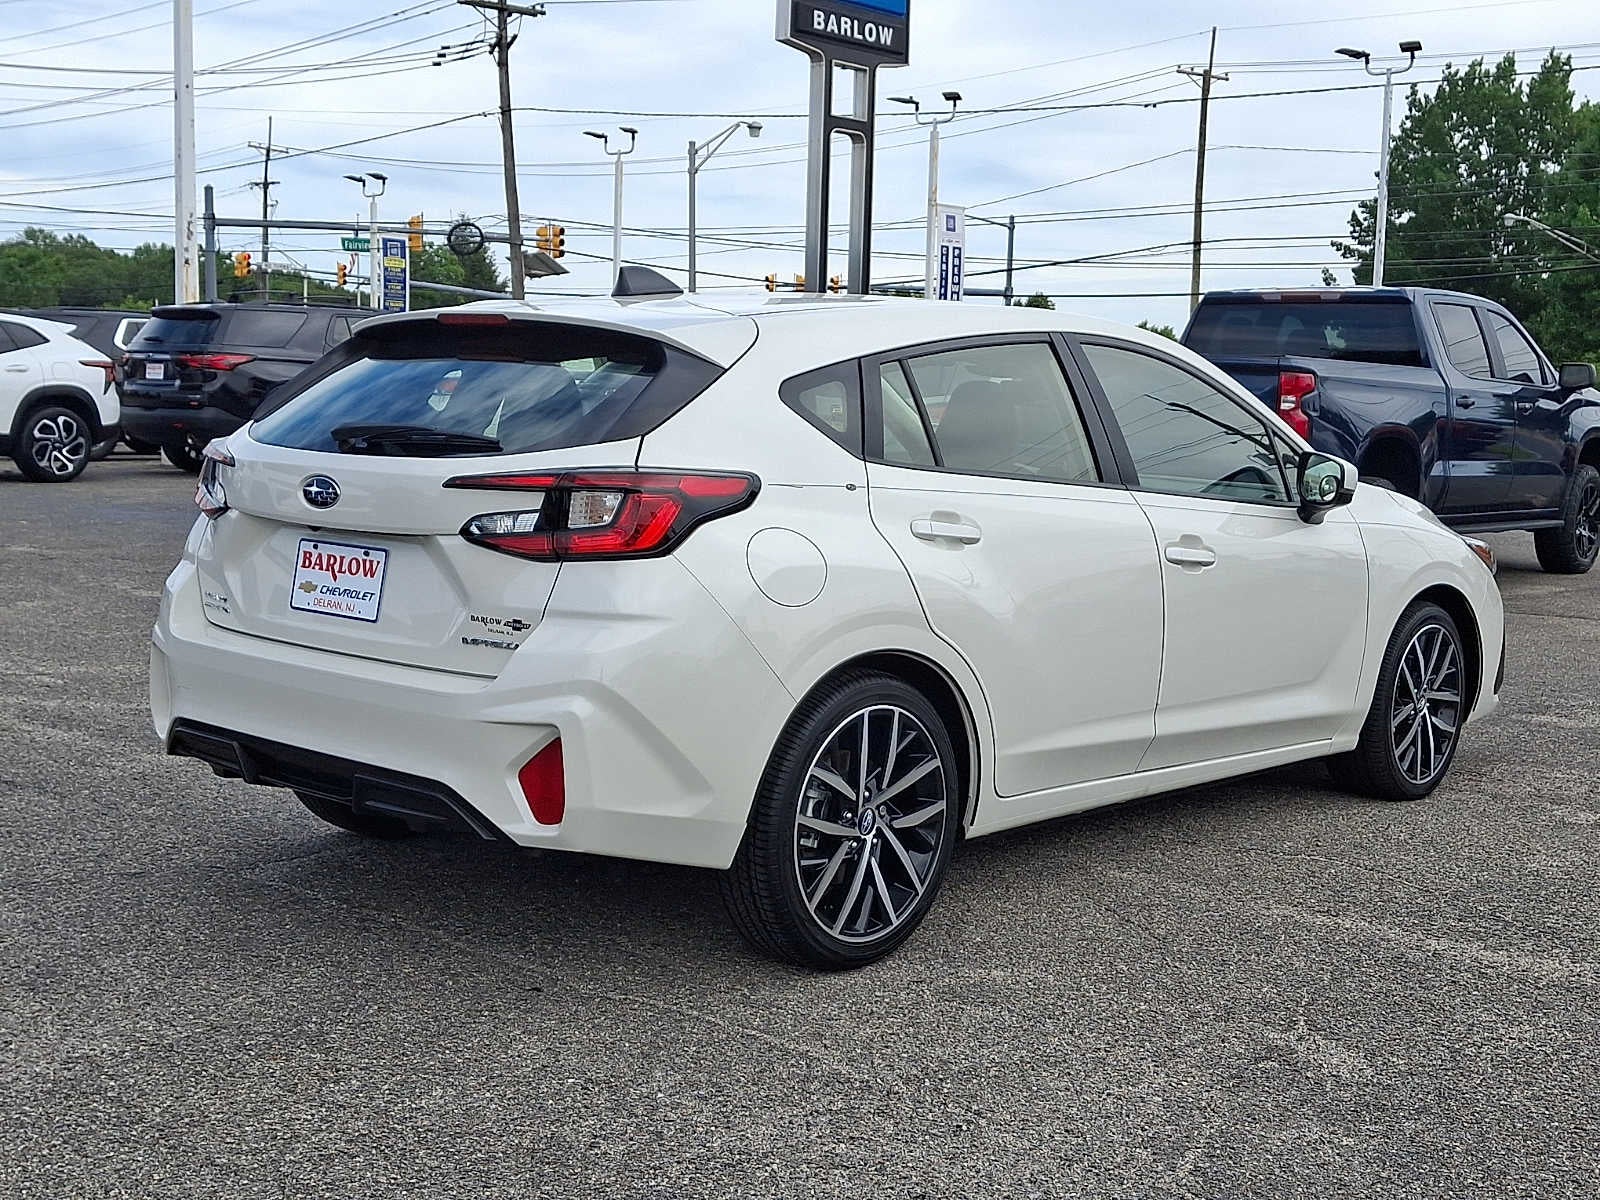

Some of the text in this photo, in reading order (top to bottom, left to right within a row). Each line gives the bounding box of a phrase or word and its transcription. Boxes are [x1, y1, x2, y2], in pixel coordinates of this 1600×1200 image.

[813, 9, 893, 46] BARLOW
[344, 240, 369, 250] Fairvie
[301, 550, 380, 582] BARLOW
[320, 585, 375, 602] CHEVROLET
[345, 603, 355, 612] NJ
[470, 615, 502, 626] BARLOW
